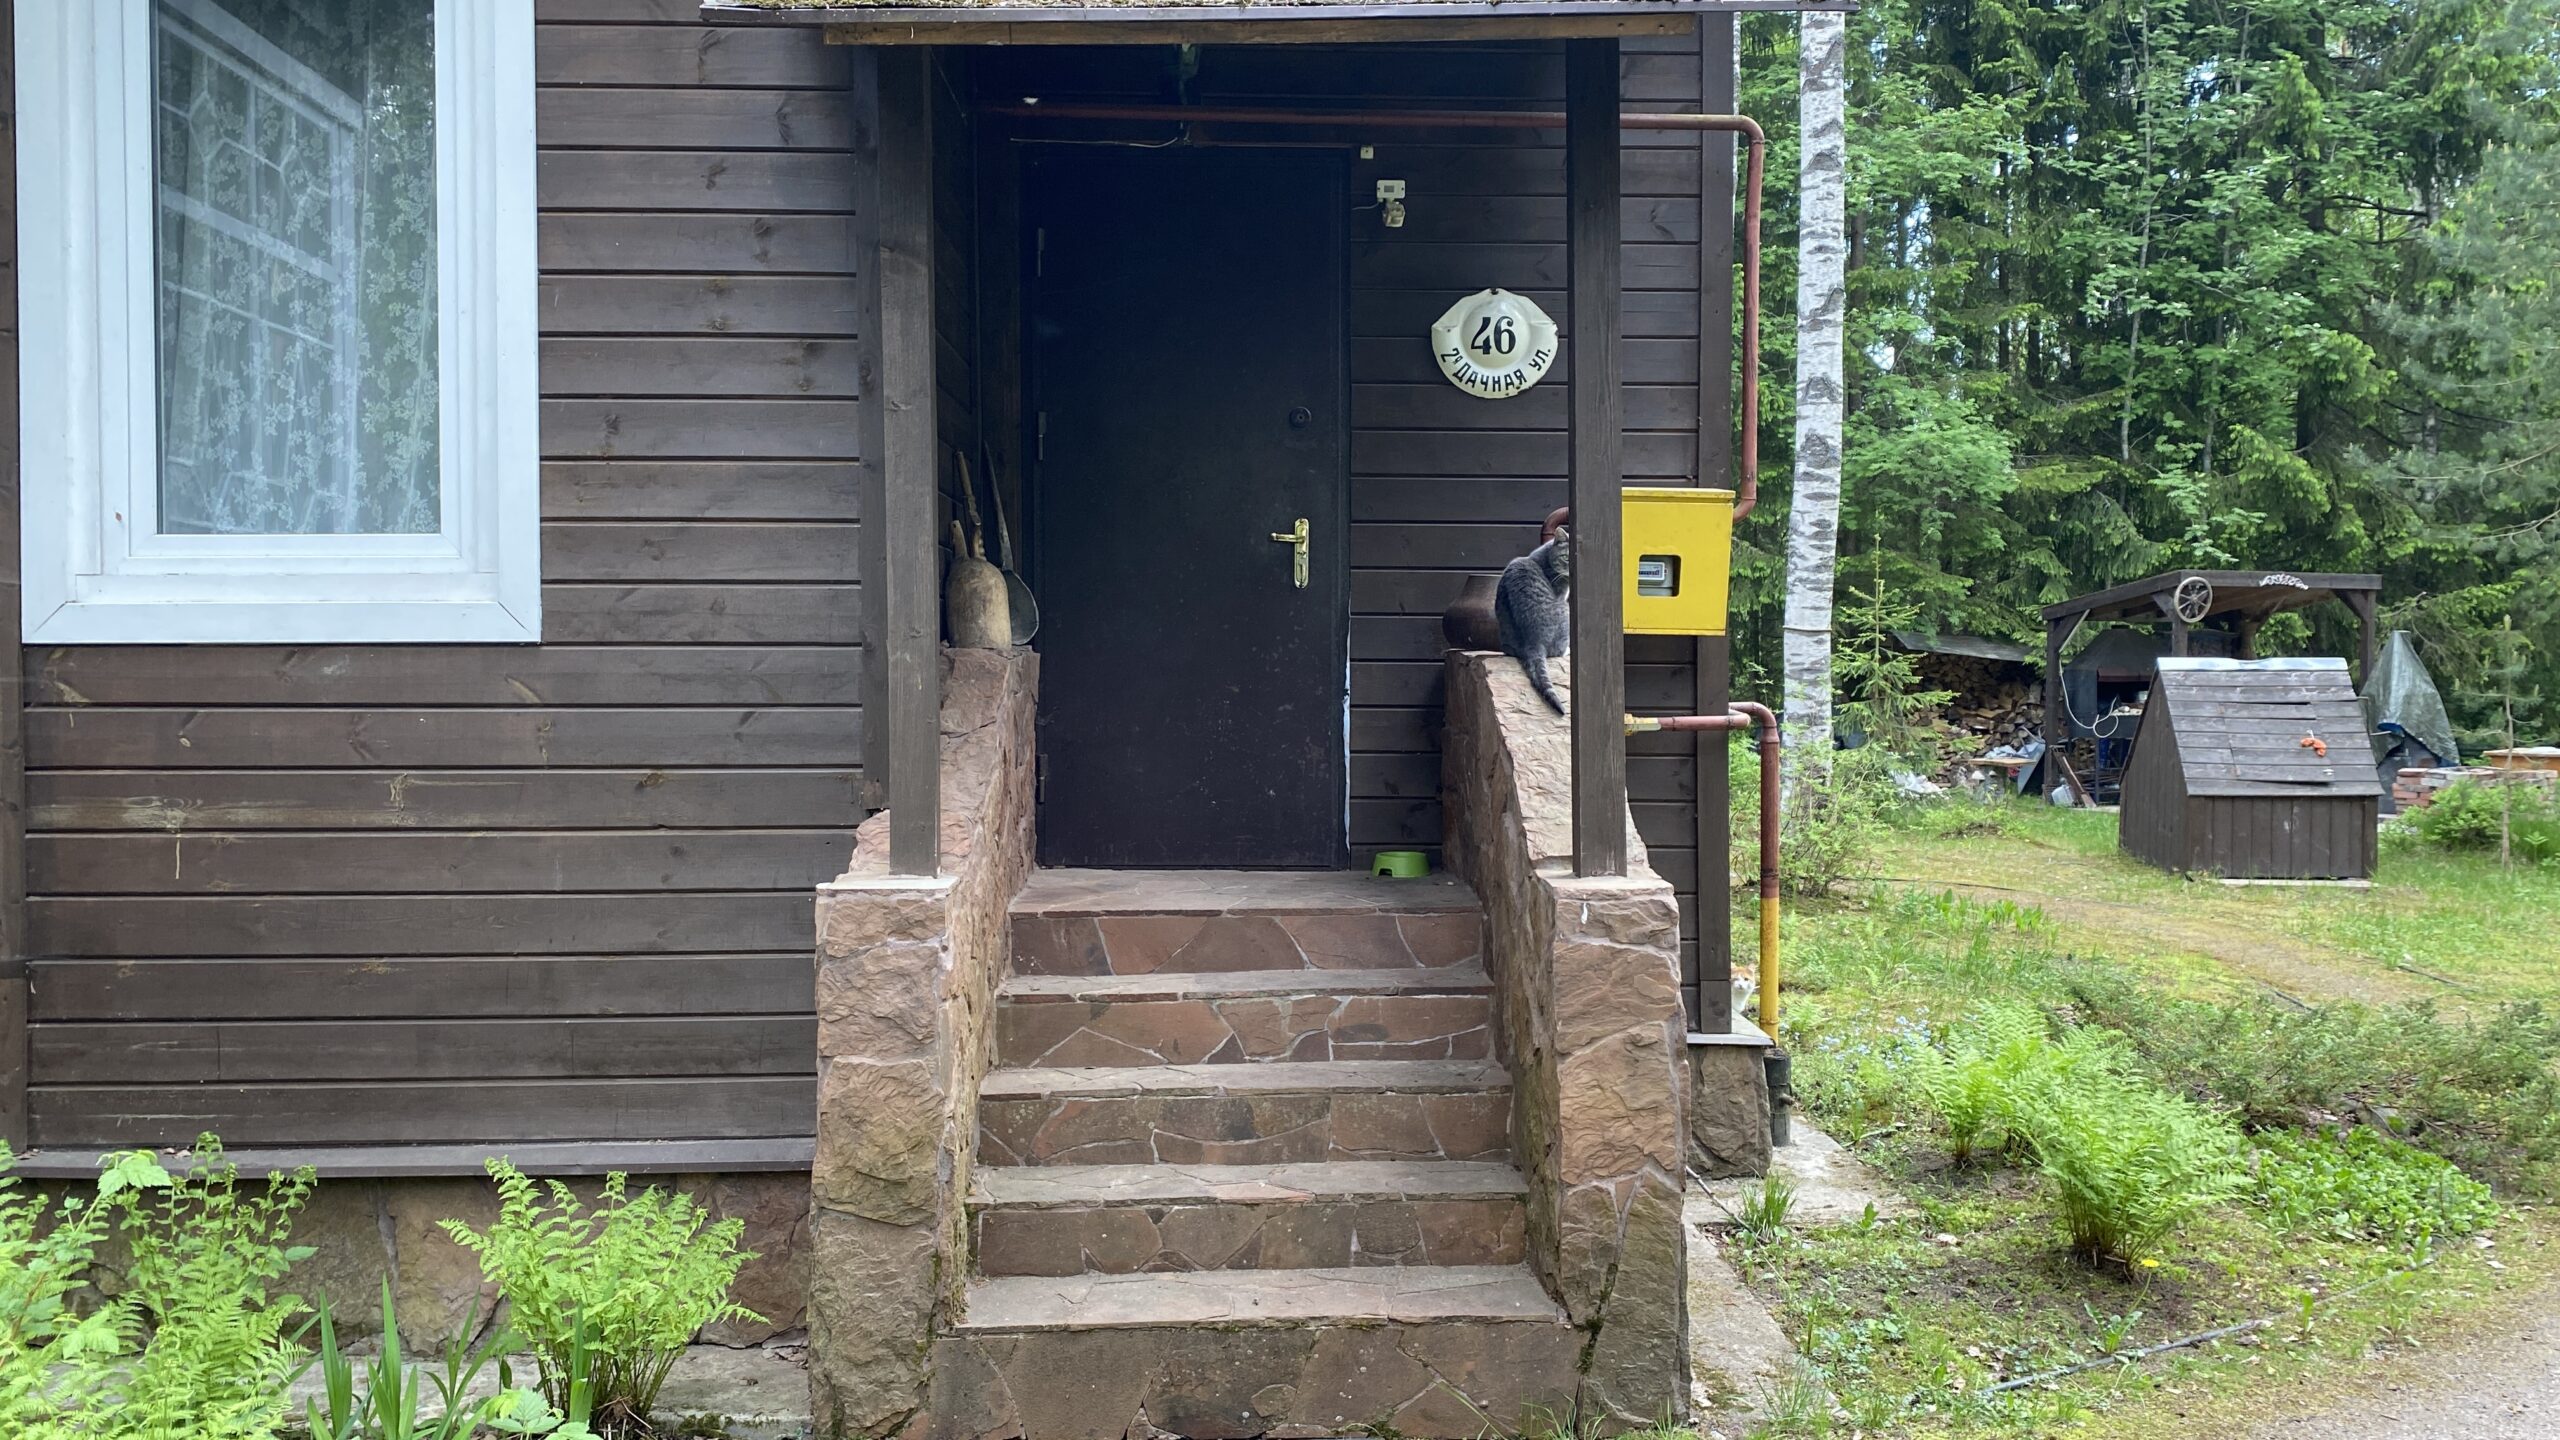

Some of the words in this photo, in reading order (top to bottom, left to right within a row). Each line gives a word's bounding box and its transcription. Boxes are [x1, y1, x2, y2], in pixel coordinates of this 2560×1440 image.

[1471, 316, 1516, 355] 46
[1452, 362, 1527, 392] ДАЧНАЯ
[1528, 348, 1551, 371] УЛ.
